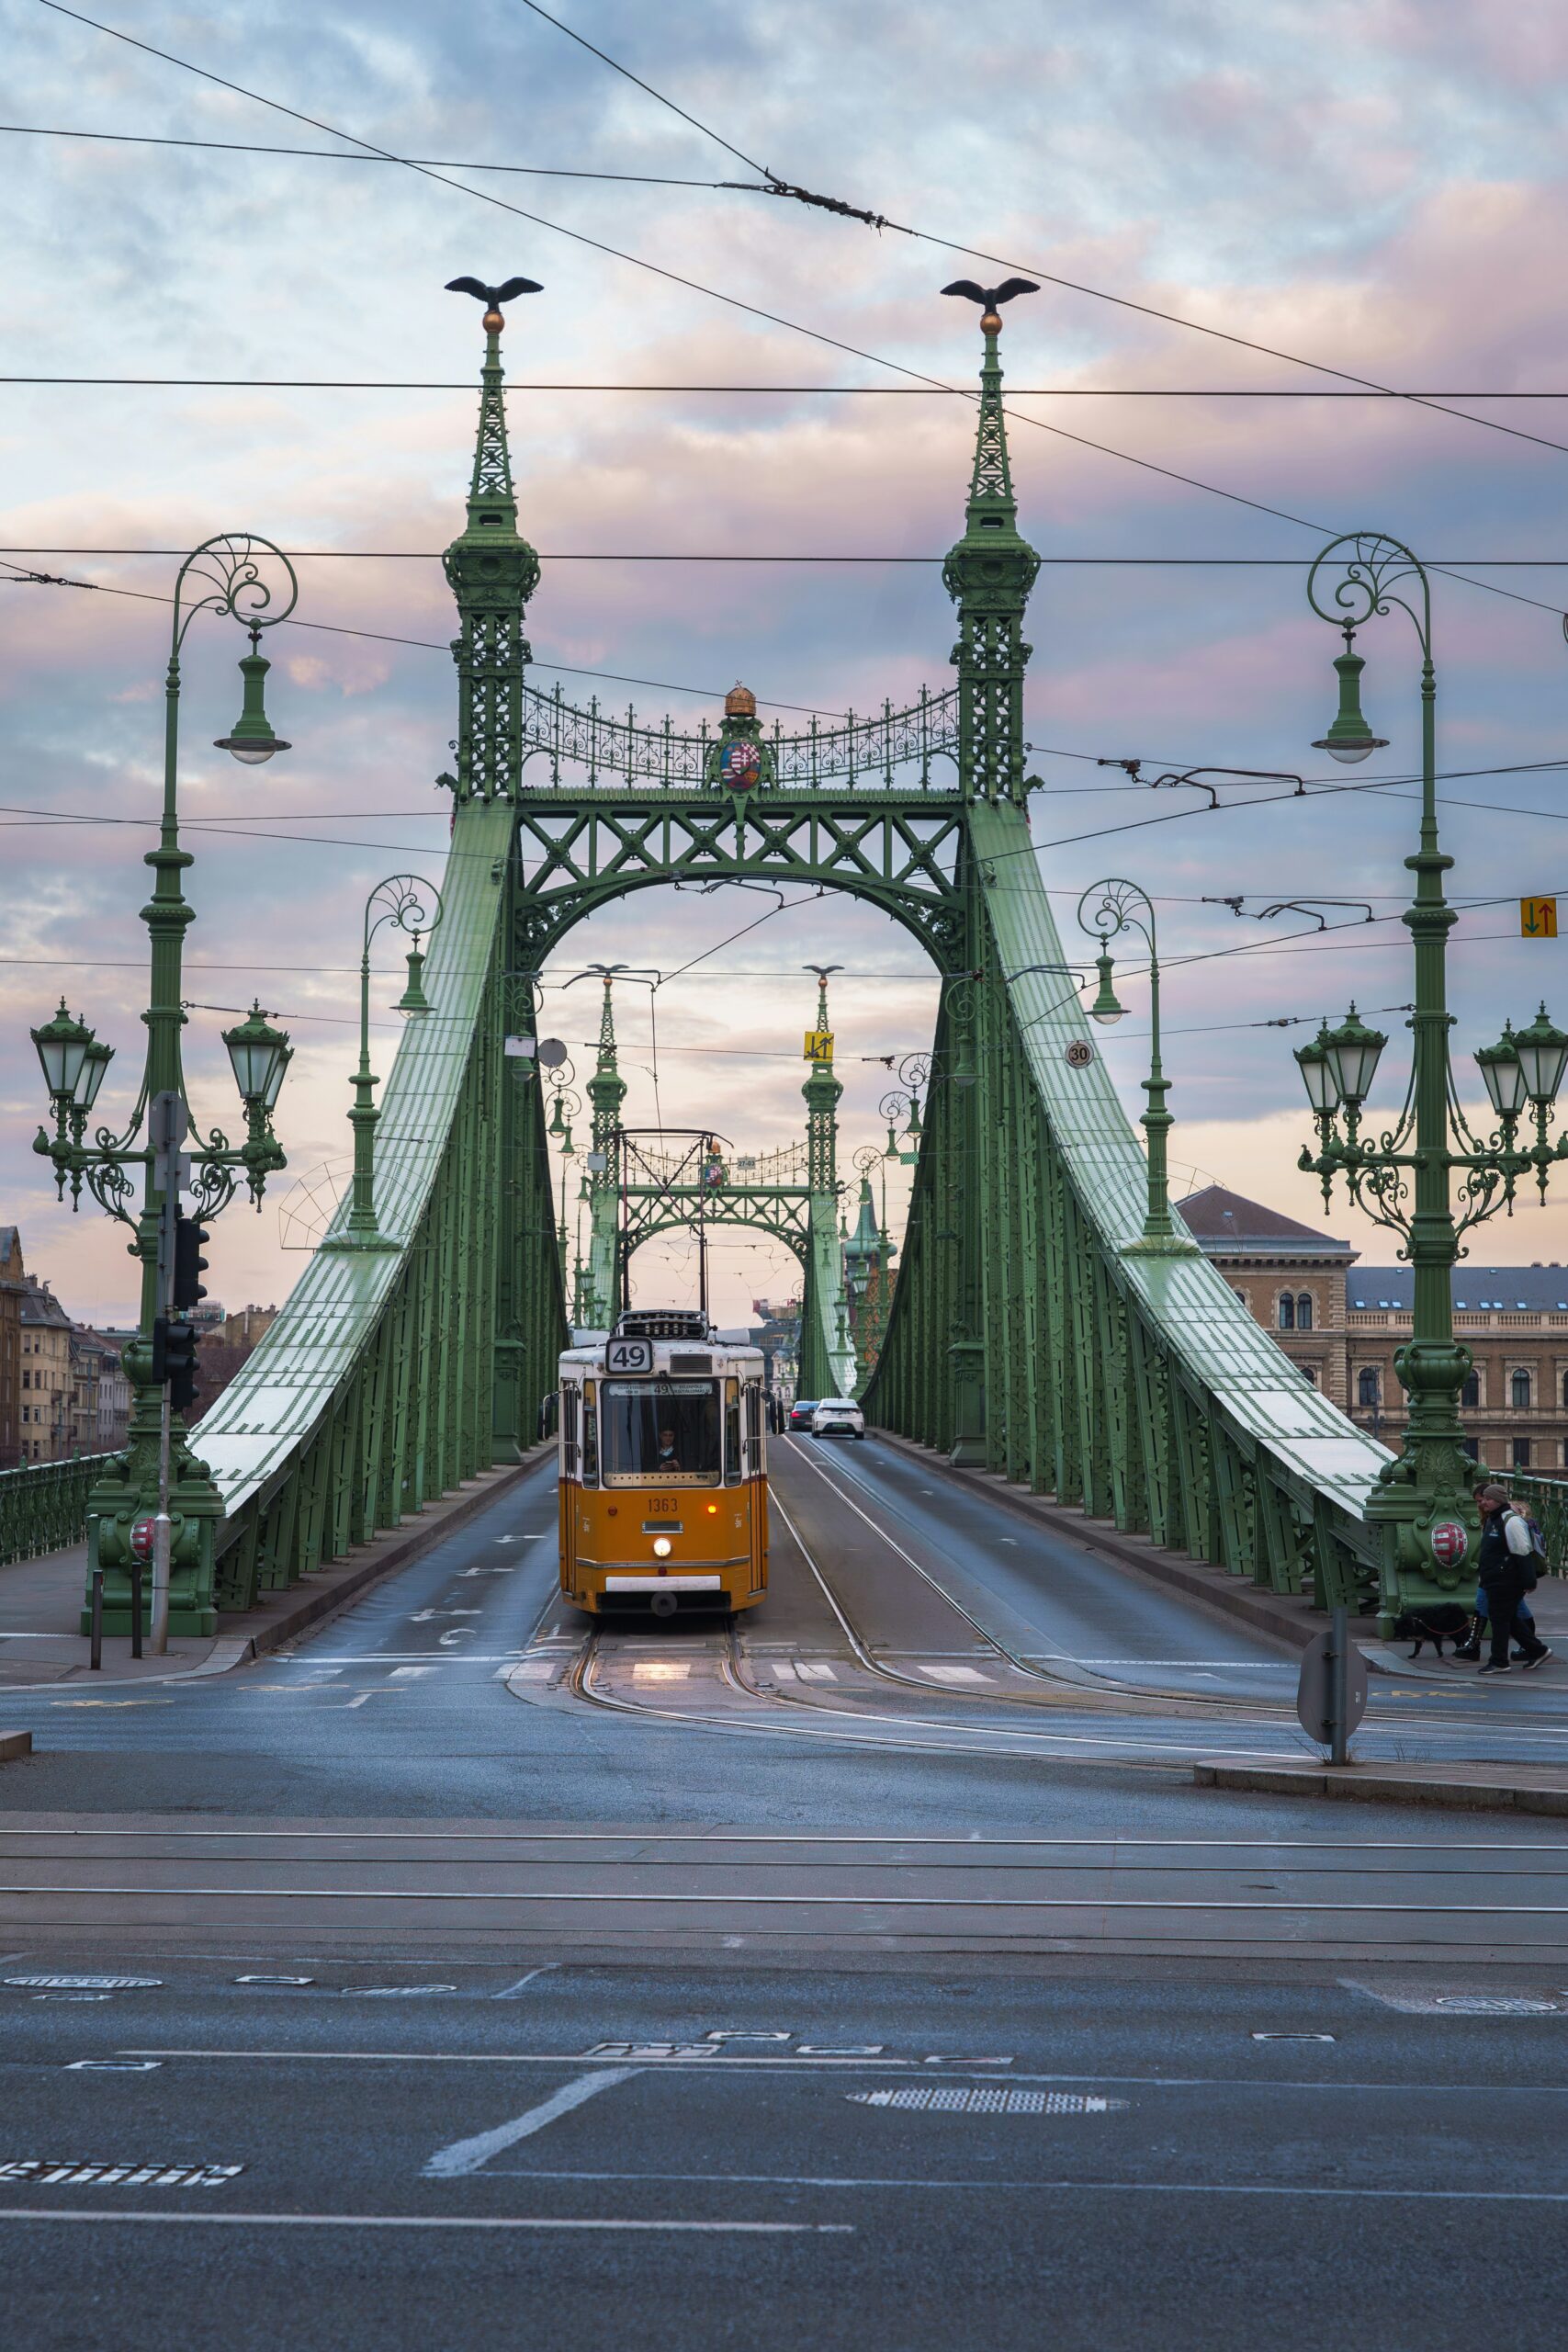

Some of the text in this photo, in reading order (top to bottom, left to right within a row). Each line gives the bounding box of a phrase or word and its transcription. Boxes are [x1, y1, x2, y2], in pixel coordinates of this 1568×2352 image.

[1071, 1047, 1088, 1061] 30
[613, 1346, 645, 1367] 49
[654, 1384, 669, 1394] 49
[649, 1498, 678, 1512] 1363
